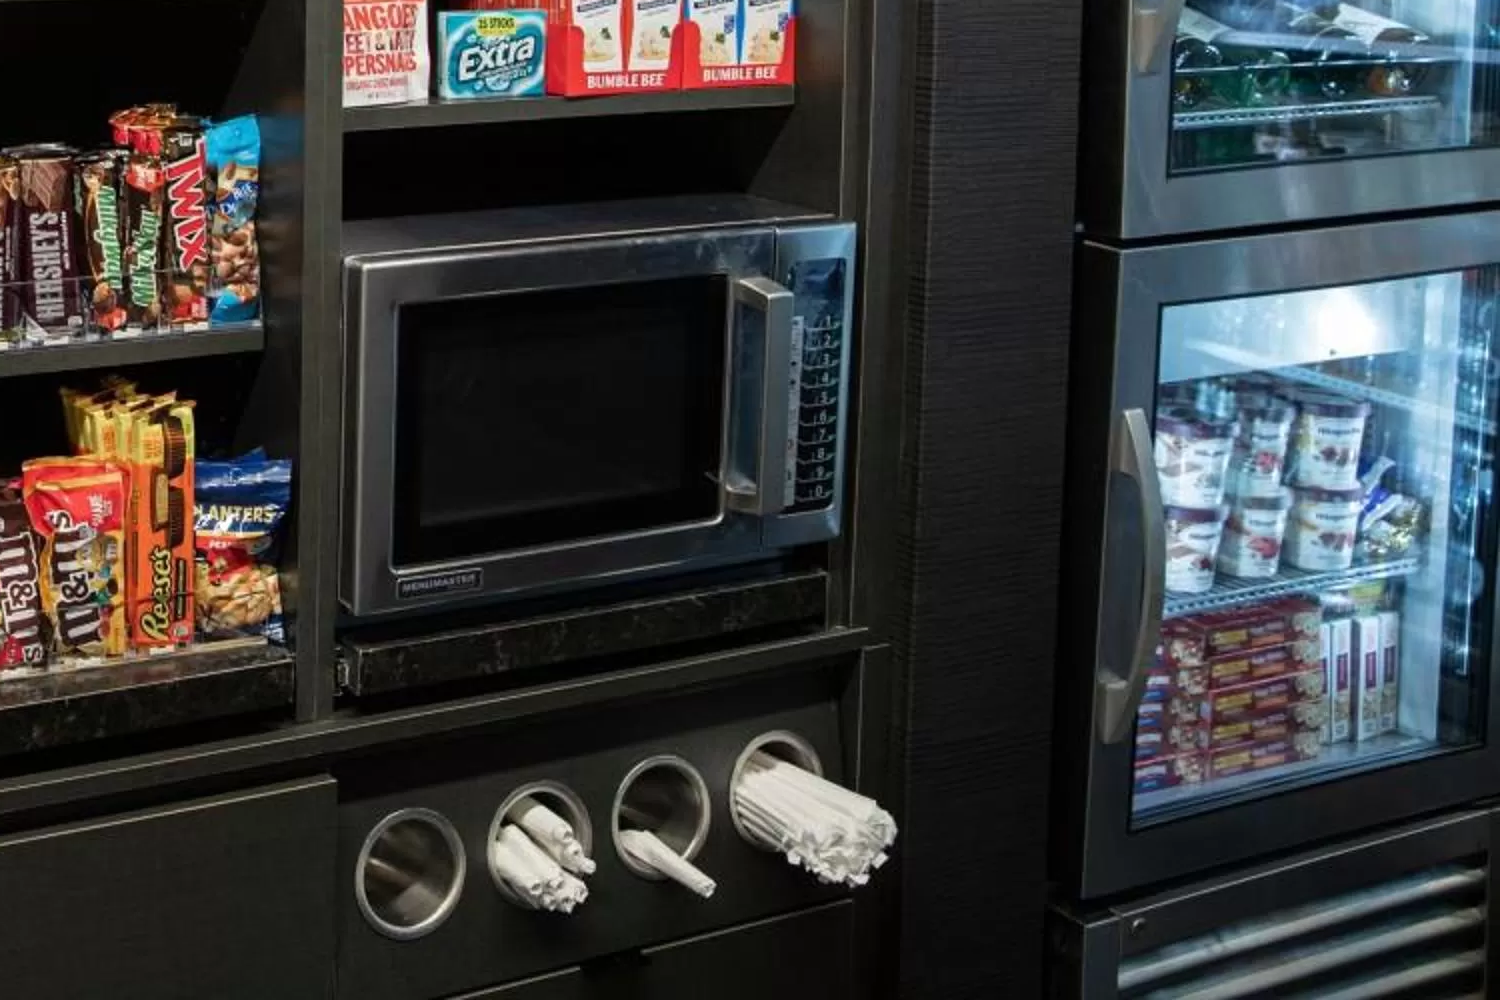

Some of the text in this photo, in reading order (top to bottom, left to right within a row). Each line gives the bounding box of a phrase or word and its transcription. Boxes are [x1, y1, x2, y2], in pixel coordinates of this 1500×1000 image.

[458, 35, 535, 81] Extra
[587, 72, 668, 90] BUMBLE BEE
[703, 65, 780, 82] BUMBLE BEE
[167, 141, 207, 271] TWIX
[29, 211, 65, 323] HERSHEY'S
[141, 546, 171, 640] Reese's
